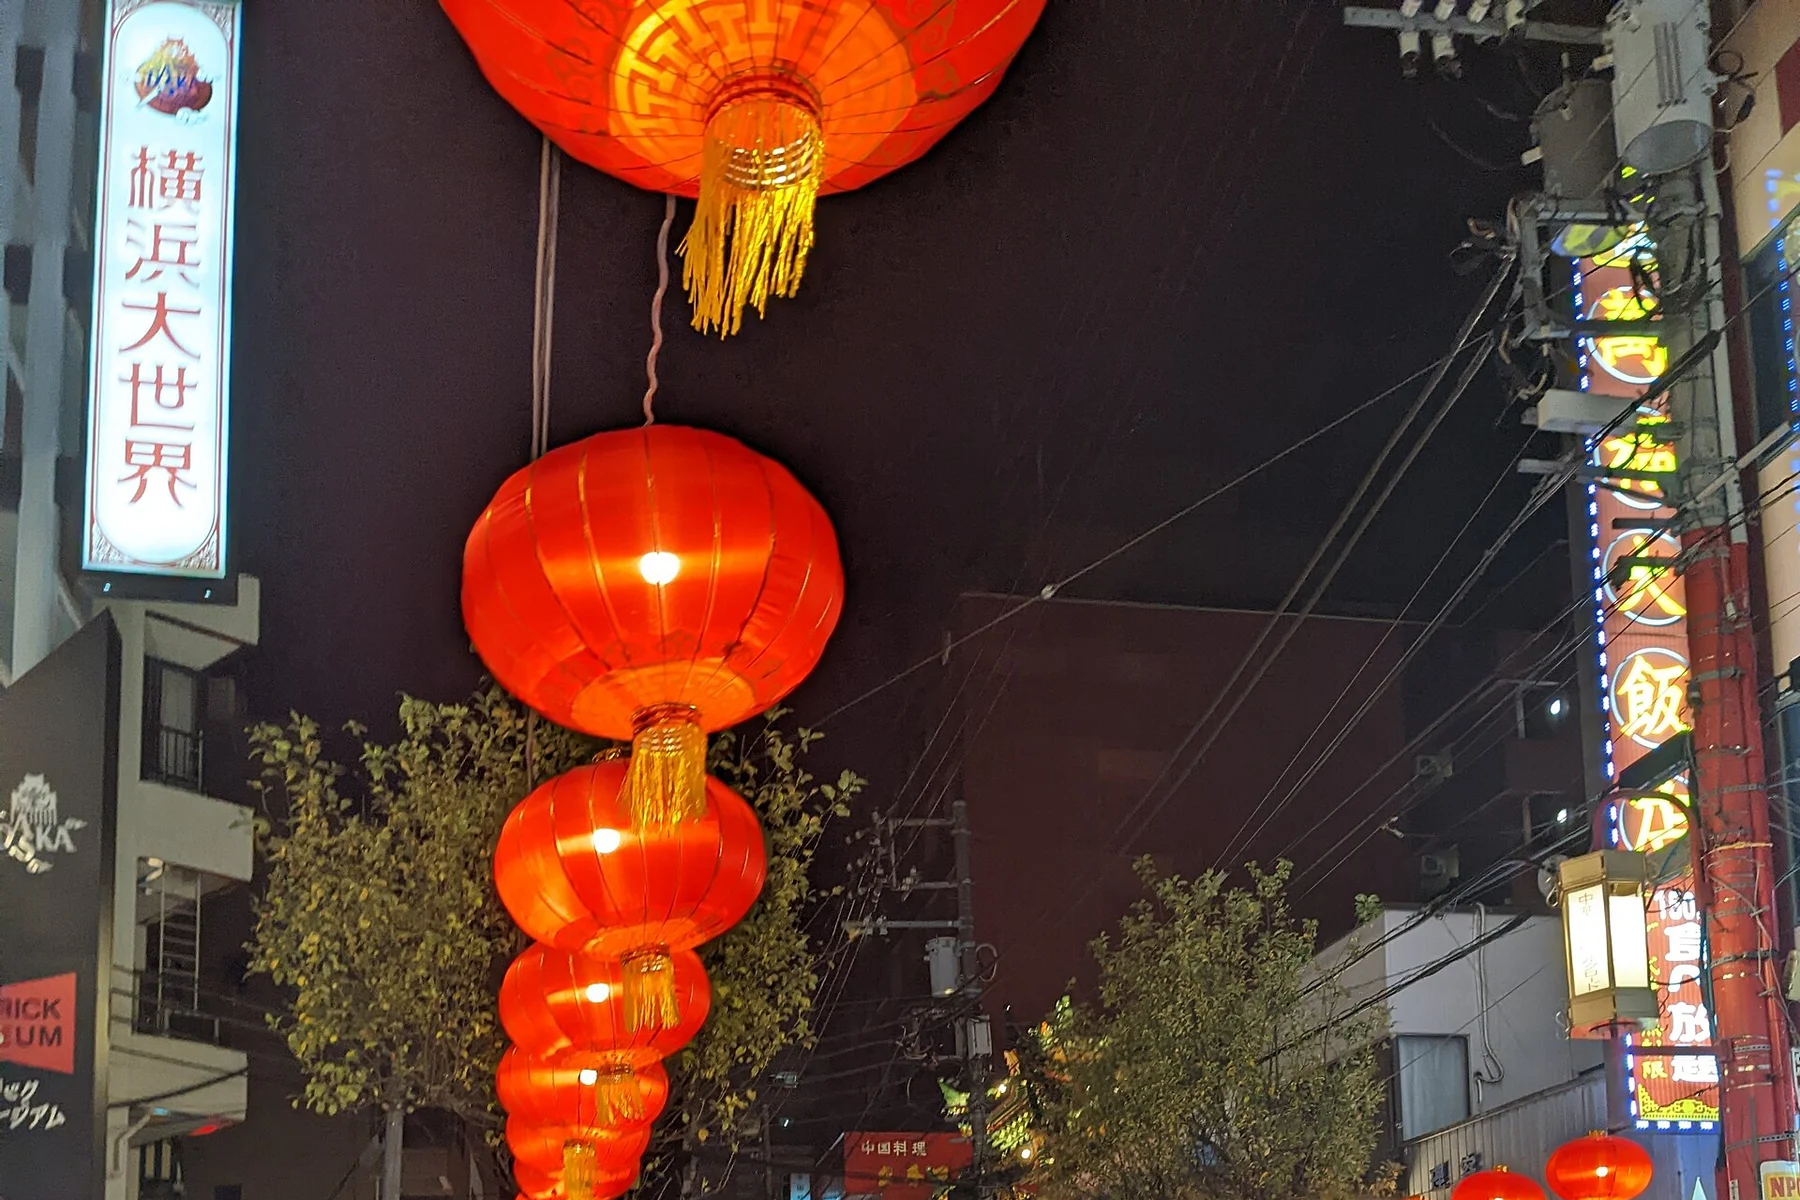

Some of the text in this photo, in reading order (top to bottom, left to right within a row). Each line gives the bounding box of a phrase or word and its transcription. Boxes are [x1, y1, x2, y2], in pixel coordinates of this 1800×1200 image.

[117, 146, 204, 509] 横浜大世界
[861, 1140, 927, 1156] 中国料理
[1770, 1176, 1800, 1198] NP
